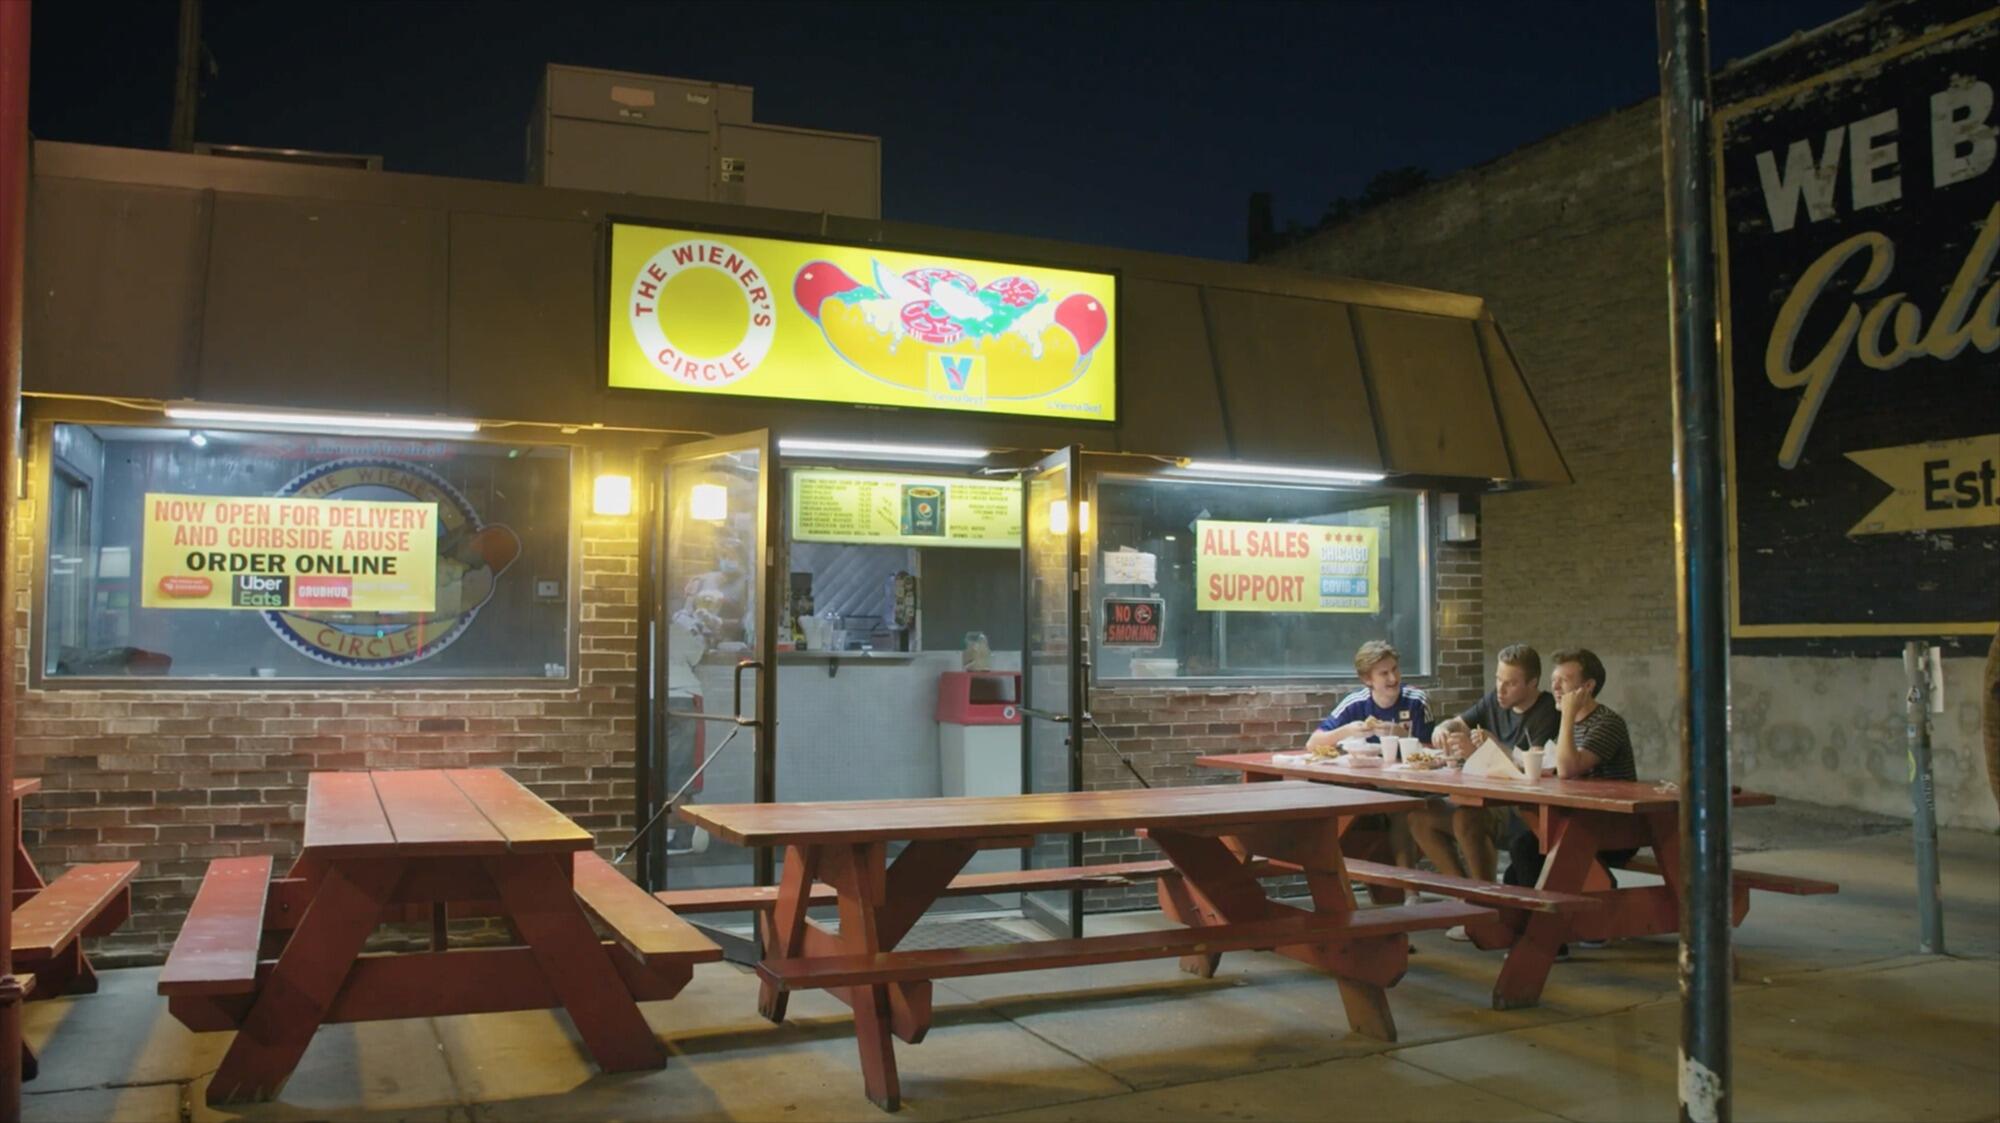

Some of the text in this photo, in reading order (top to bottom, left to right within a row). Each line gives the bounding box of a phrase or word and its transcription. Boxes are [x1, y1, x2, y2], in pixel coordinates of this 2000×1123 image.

[1755, 107, 1902, 233] WE
[635, 244, 772, 327] THE WIENER'S
[658, 348, 750, 381] CIRCLE
[154, 500, 428, 530] NOW OPEN FOR DELIVERY
[174, 524, 411, 552] AND CURBSIDE ABUSE
[1203, 528, 1311, 559] ALL SALES
[186, 551, 398, 575] ORDER ONLINE
[1320, 545, 1369, 562] CHICAGO
[240, 575, 282, 591] Uber
[298, 585, 349, 599] GRUBHUB
[1208, 573, 1305, 602] SUPPORT
[240, 591, 282, 606] Eats
[1115, 604, 1131, 622] NO
[316, 629, 417, 657] CIRCLE
[1108, 623, 1157, 641] SMOKING
